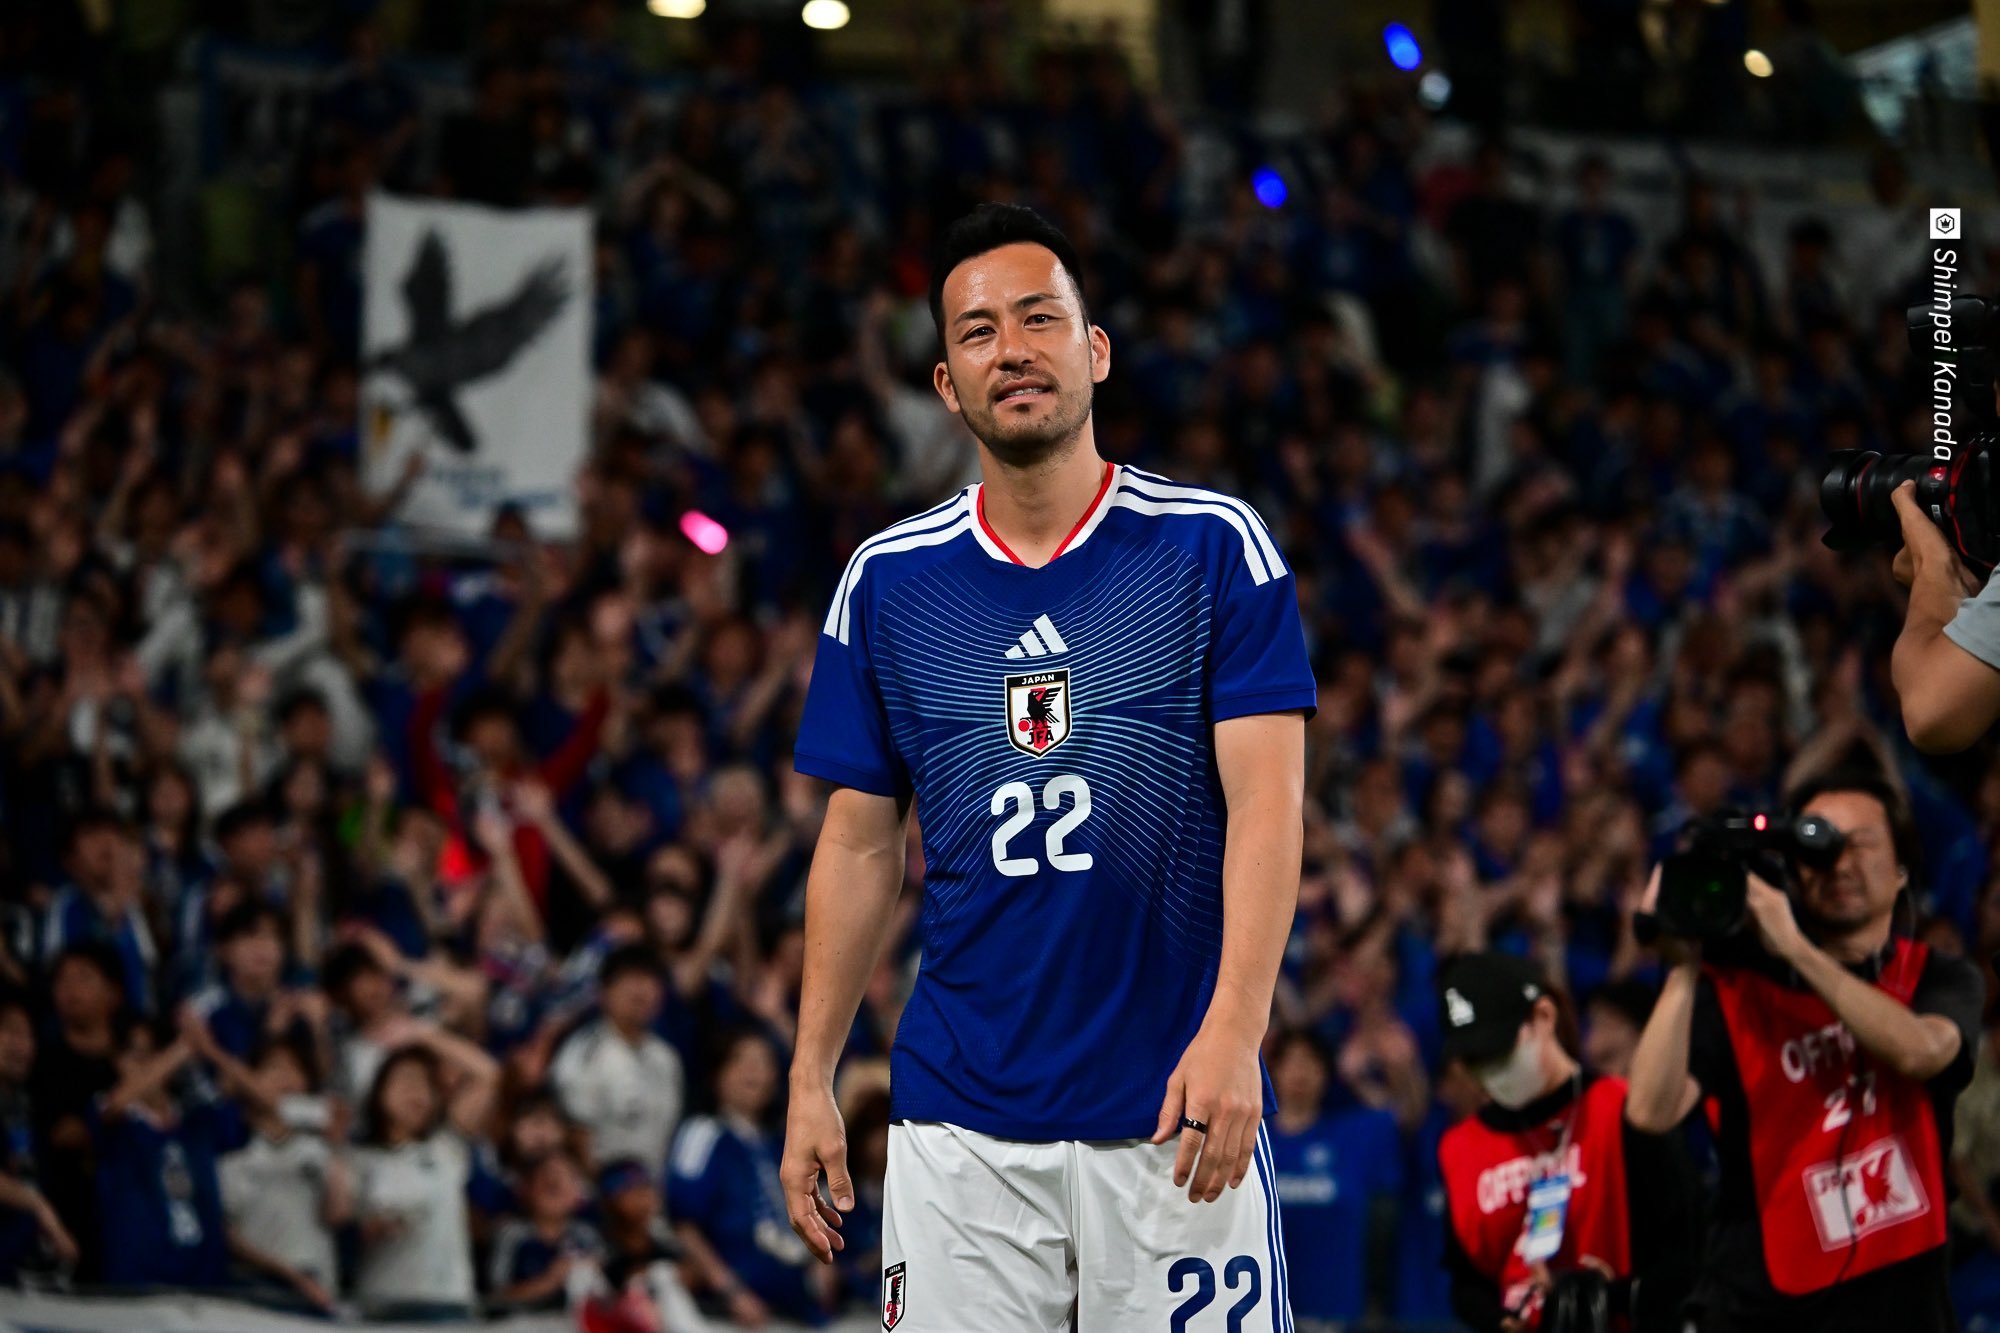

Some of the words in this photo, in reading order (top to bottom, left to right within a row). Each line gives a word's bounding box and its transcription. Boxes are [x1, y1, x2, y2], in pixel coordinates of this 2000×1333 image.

[1021, 673, 1055, 685] JAPAN
[1027, 730, 1055, 745] JFA
[990, 775, 1094, 877] 22
[1168, 1255, 1261, 1333] 22
